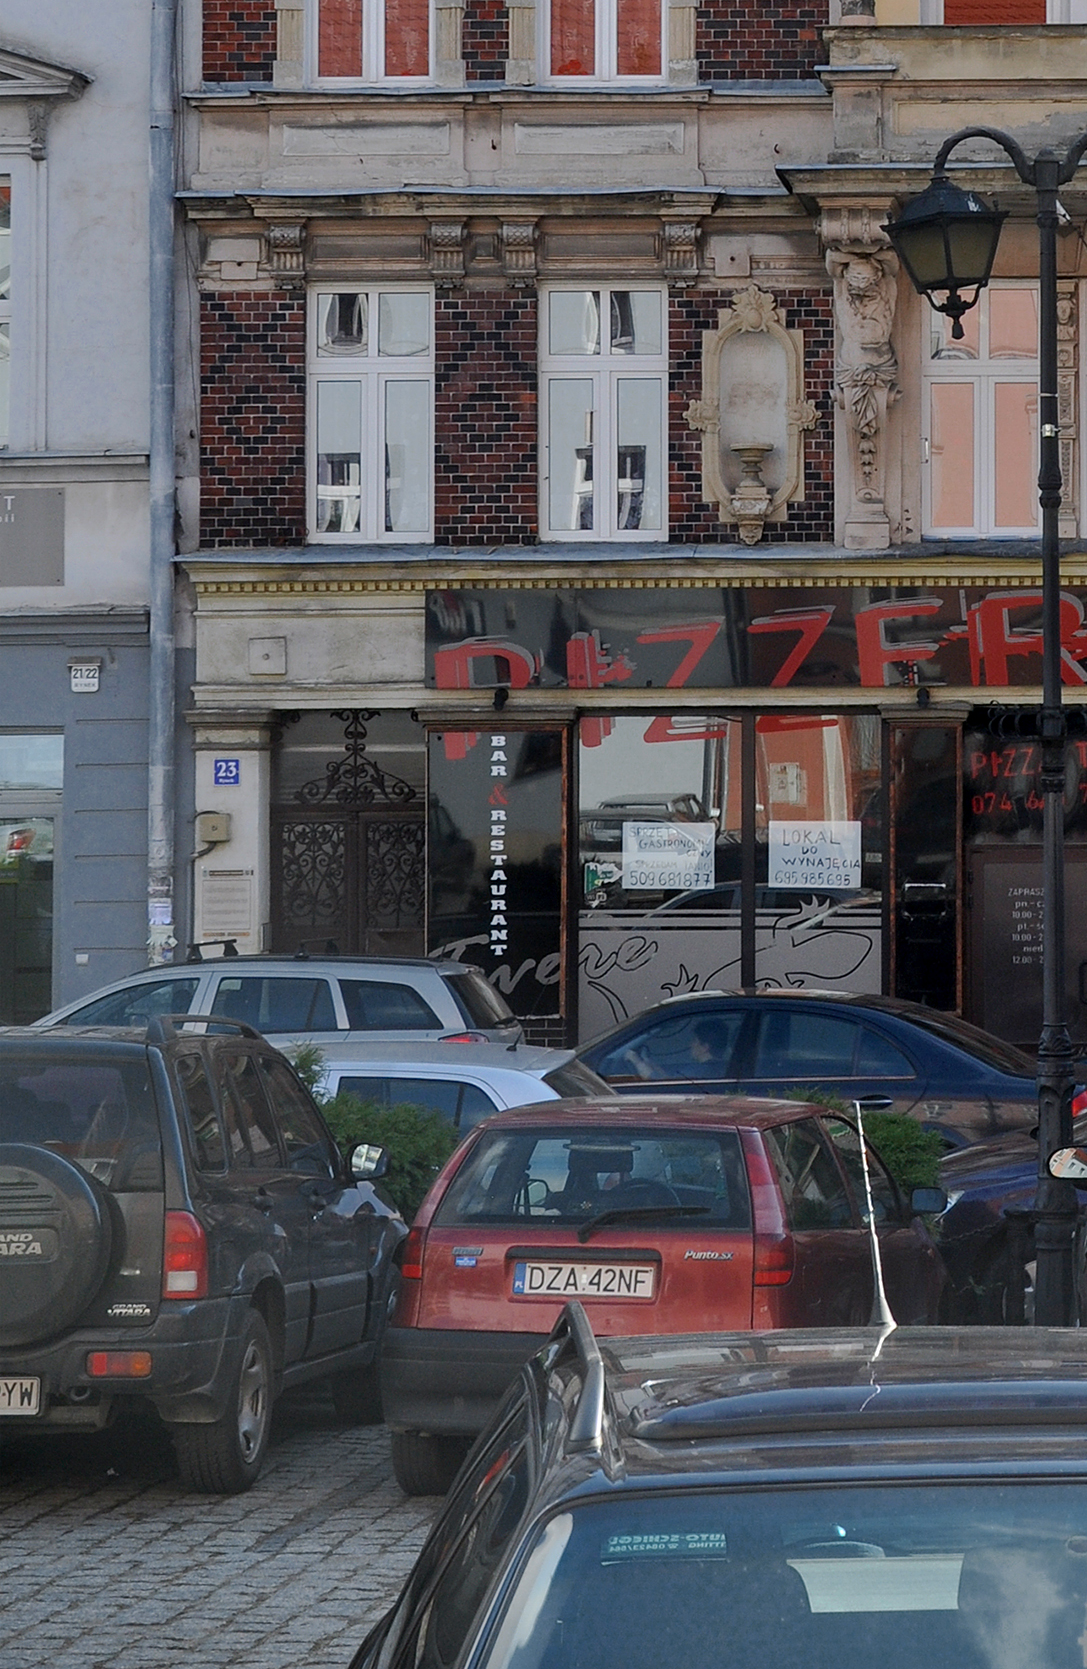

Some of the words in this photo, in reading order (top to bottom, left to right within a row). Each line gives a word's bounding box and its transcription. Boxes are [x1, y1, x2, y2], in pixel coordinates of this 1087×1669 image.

[490, 736, 507, 776] BAR
[971, 748, 1042, 779] PIZZ
[216, 761, 237, 777] 23
[782, 829, 841, 846] LOKAL
[782, 857, 861, 870] WYNAJĘCIA
[490, 810, 508, 956] RESTAURANT
[1008, 888, 1044, 896] ZAPRASZ
[428, 934, 658, 994] Tvere
[684, 1249, 719, 1261] Punto
[529, 1266, 581, 1291] DZA
[588, 1268, 652, 1294] 42NF
